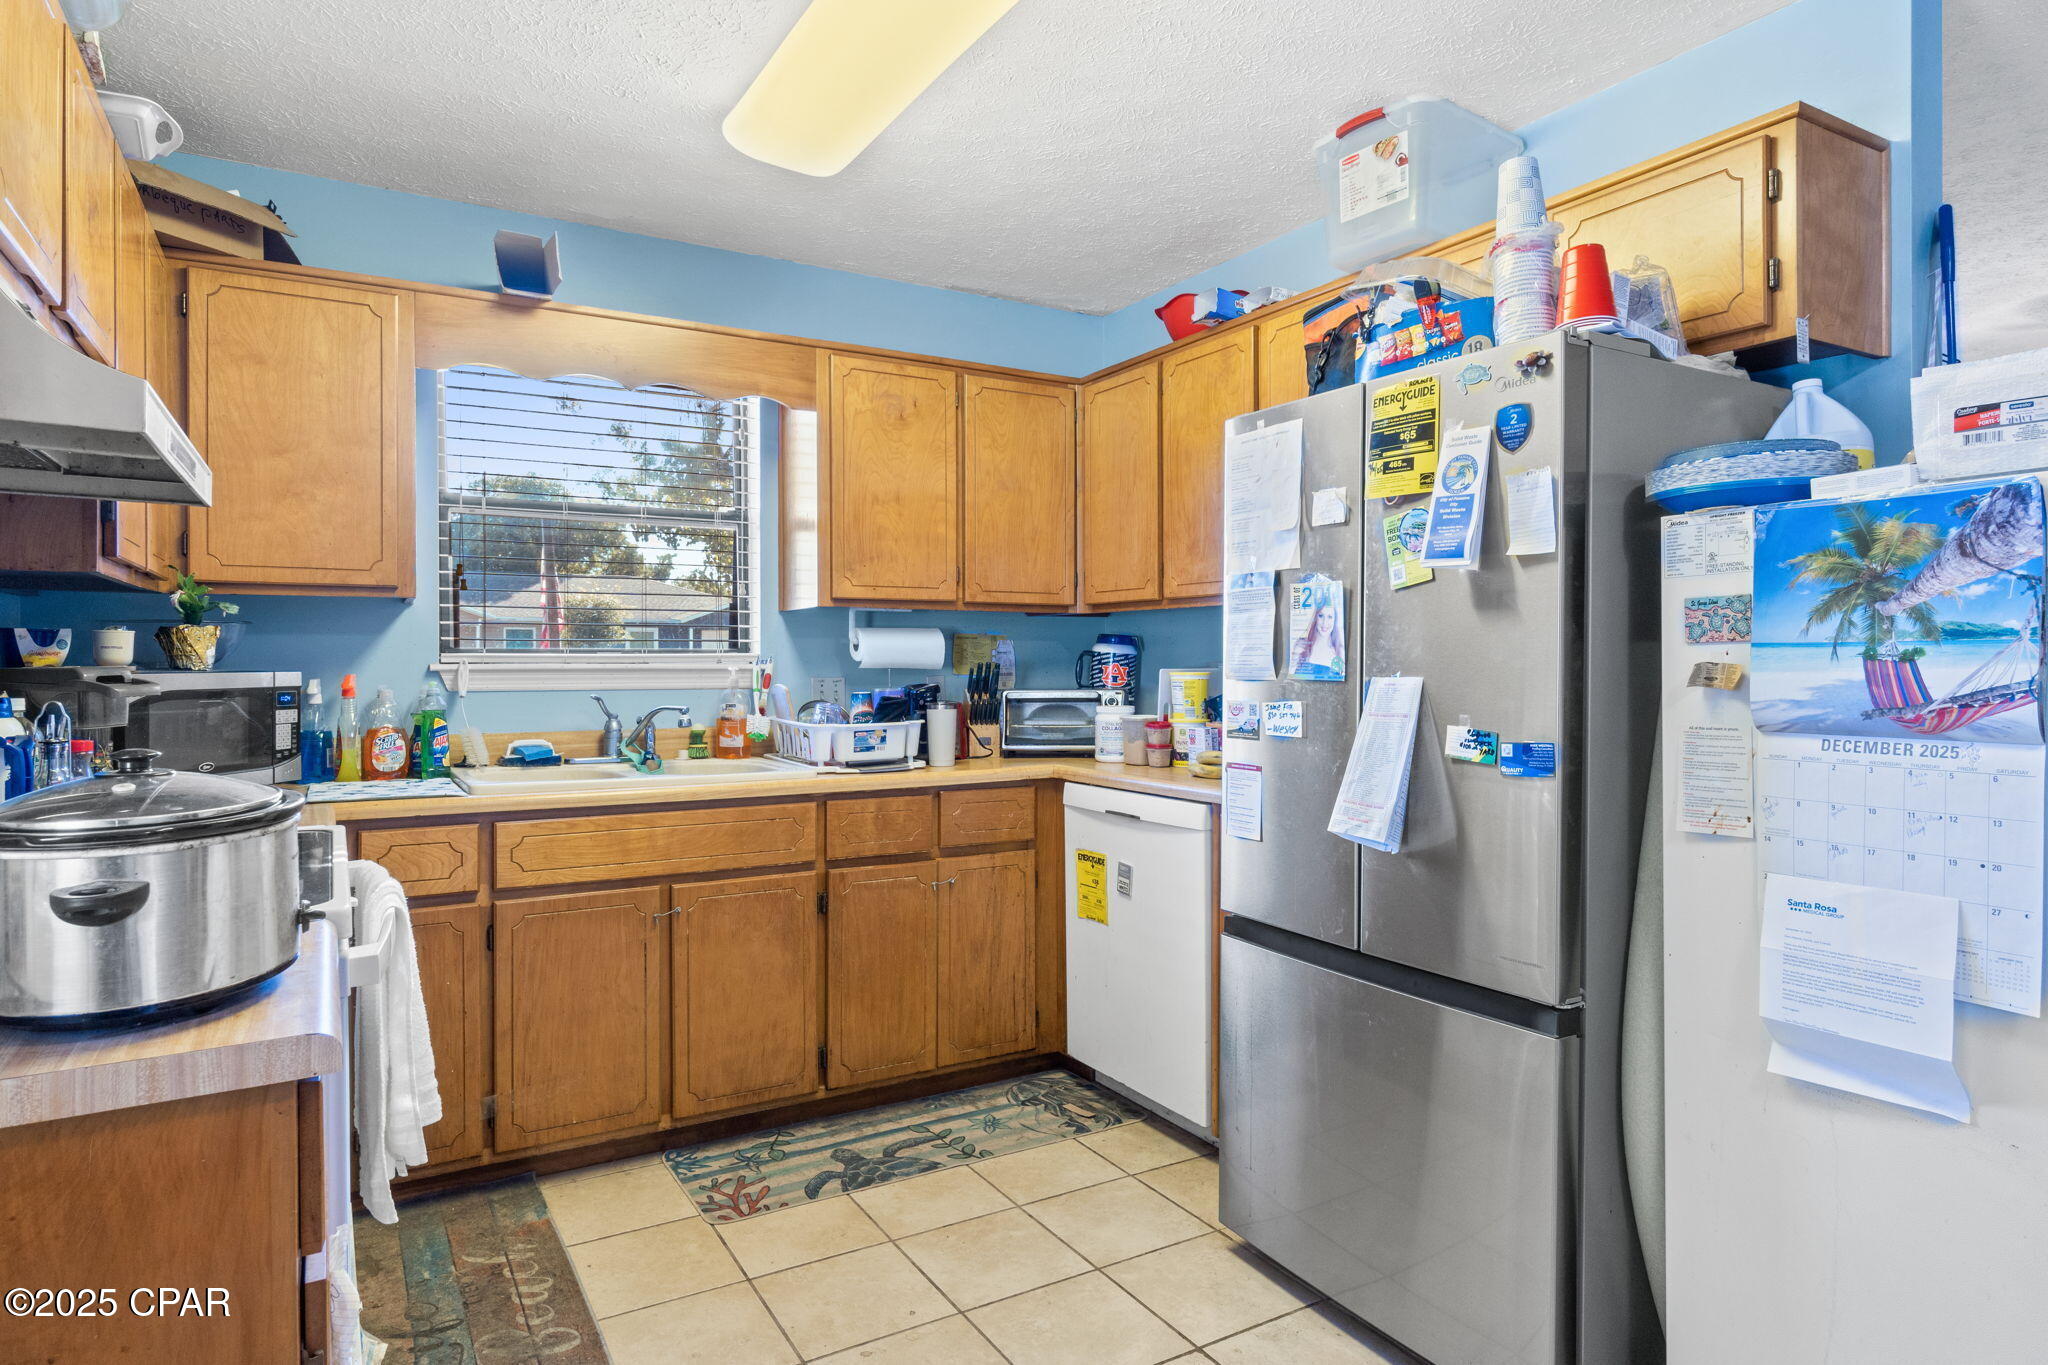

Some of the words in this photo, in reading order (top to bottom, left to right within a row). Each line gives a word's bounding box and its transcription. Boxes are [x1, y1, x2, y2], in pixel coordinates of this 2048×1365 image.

[1467, 340, 1483, 354] 18
[1495, 376, 1536, 392] Midea
[1373, 384, 1436, 409] ENERGYGUIDE
[1510, 413, 1519, 424] 2
[1400, 429, 1417, 441] $65
[1665, 519, 1689, 528] Midea
[434, 735, 448, 748] AJA
[1821, 738, 1913, 757] DECEMBER
[1920, 744, 1960, 760] 2025
[1907, 769, 1913, 777] 4
[1996, 768, 2029, 776] SATURDAY
[1993, 775, 1999, 783] 6
[1907, 811, 1916, 819] 11
[1949, 815, 1958, 823] 12
[1993, 819, 2002, 827] 13
[1796, 839, 1804, 847] 15
[1907, 853, 1916, 861] 18
[1948, 859, 1958, 867] 19
[1991, 864, 2002, 872] 20
[1787, 898, 1812, 909] Santa
[1814, 902, 1837, 913] Rosa
[1991, 908, 2001, 916] 27
